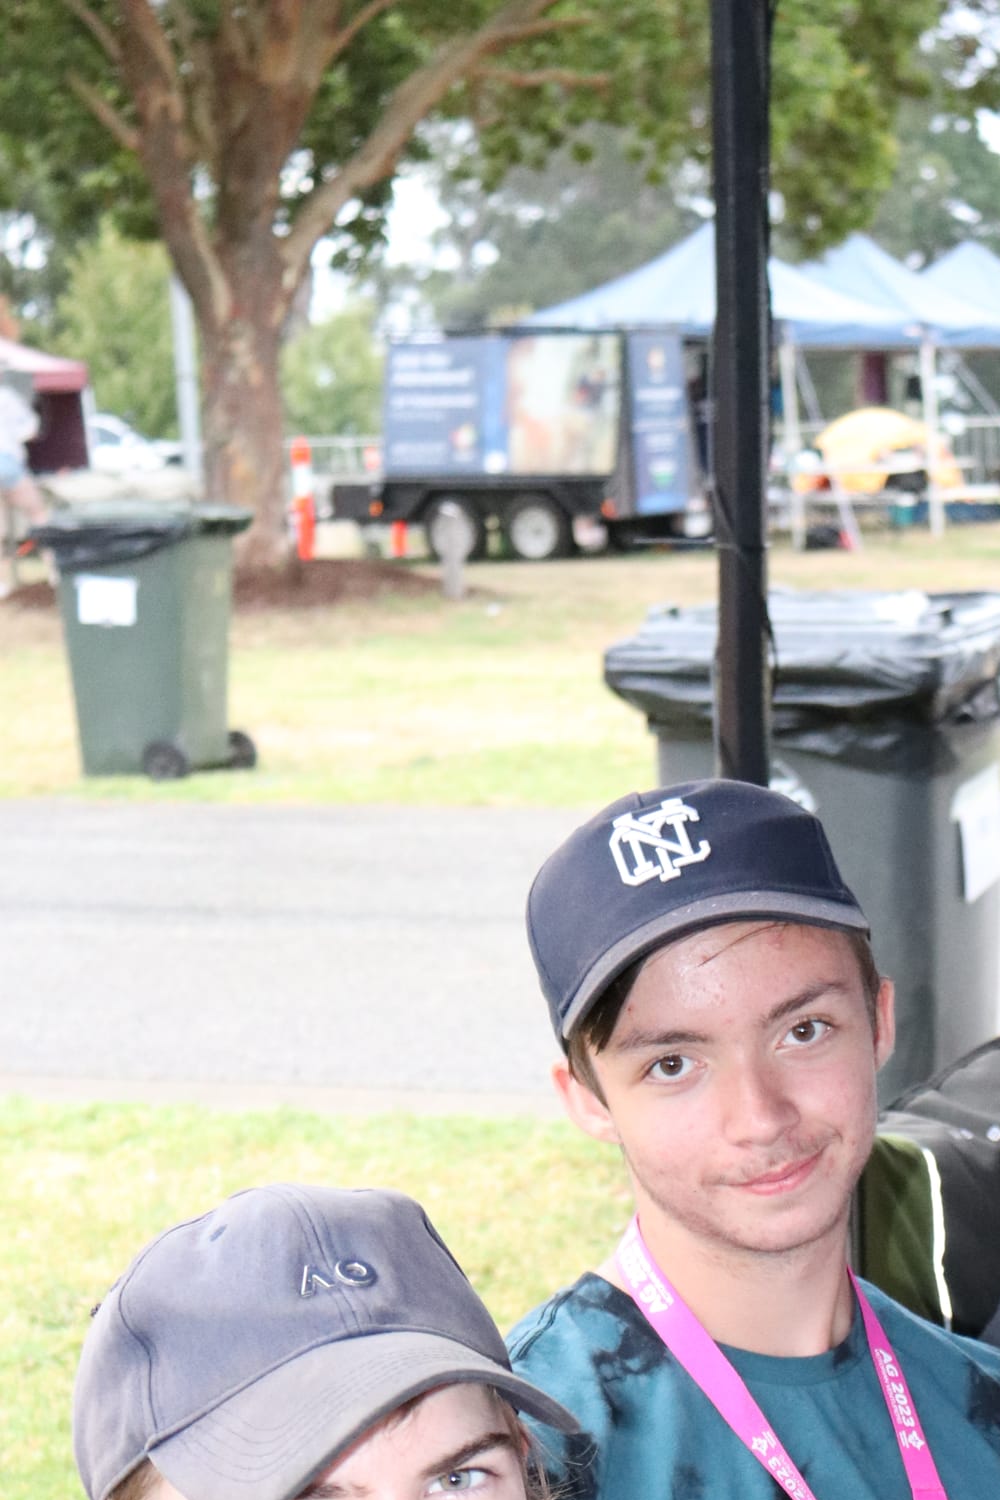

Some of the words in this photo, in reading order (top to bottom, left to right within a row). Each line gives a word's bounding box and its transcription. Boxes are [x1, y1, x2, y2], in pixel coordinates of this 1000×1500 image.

[300, 1259, 379, 1298] AO
[638, 1284, 669, 1314] AG
[878, 1349, 899, 1377] AG
[890, 1382, 915, 1428] 2023
